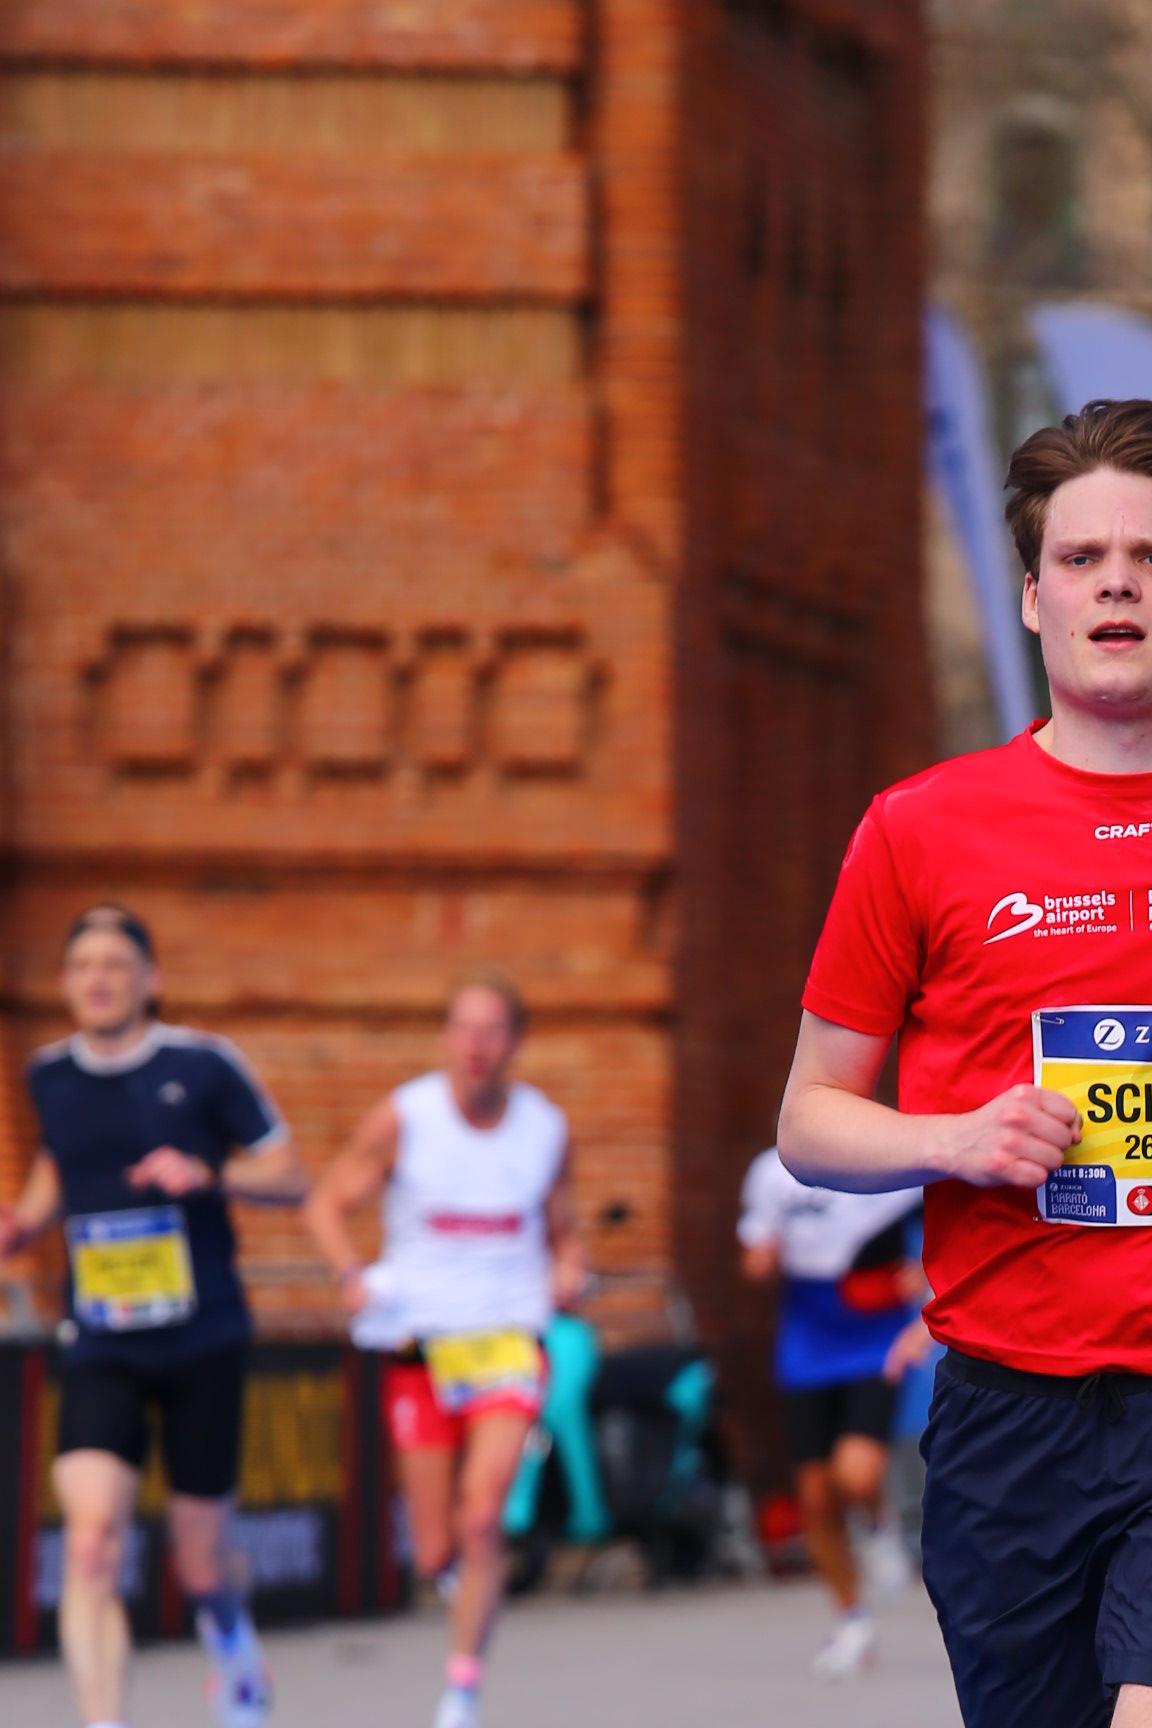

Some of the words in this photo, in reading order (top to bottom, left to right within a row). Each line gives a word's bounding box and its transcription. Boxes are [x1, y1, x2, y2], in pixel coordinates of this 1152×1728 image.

[1044, 890, 1116, 910] brussels
[1045, 907, 1105, 925] airport
[1033, 928, 1048, 937] the
[1050, 926, 1074, 936] heart
[1076, 925, 1085, 934] of
[1086, 923, 1117, 934] Europe
[1051, 1204, 1106, 1217] BARCELONA
